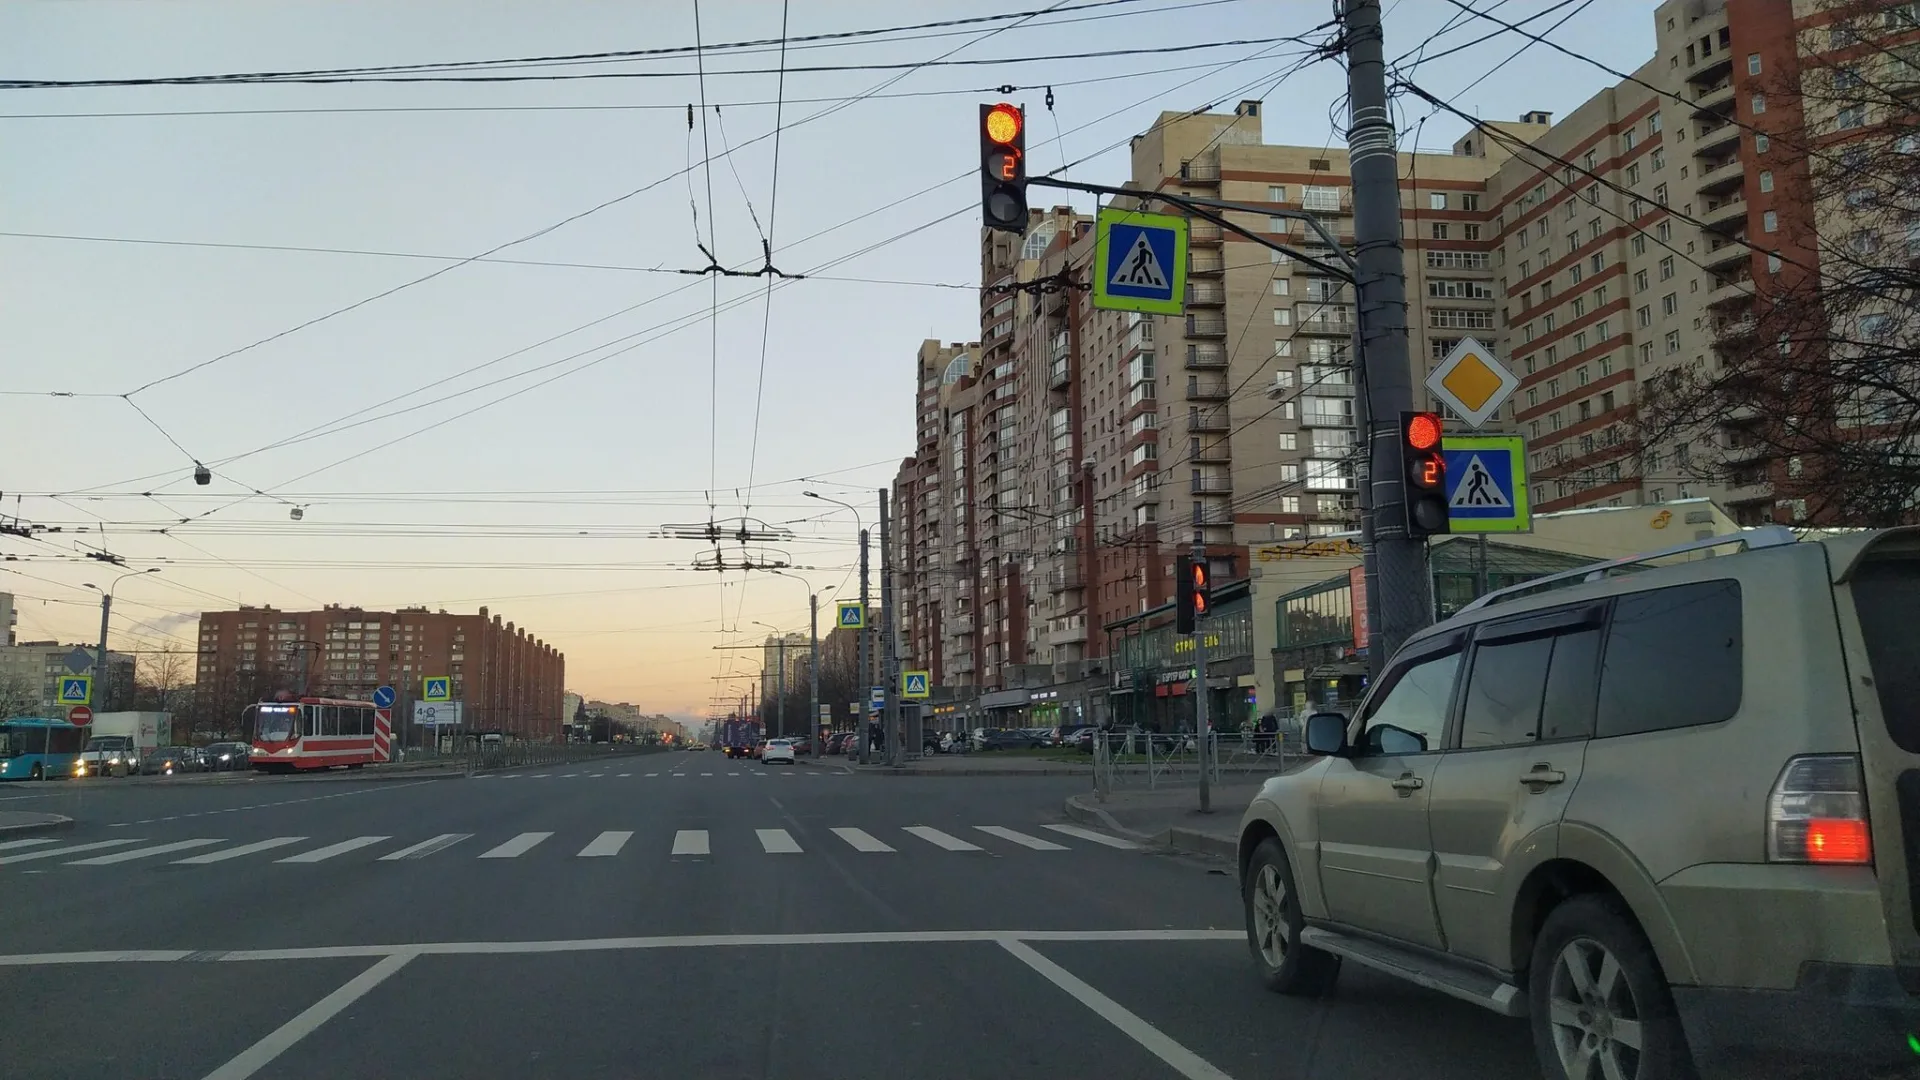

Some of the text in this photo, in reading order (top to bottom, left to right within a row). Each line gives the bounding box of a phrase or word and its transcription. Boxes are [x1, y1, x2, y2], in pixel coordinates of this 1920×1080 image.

[1003, 156, 1014, 177] 2
[1425, 462, 1436, 482] 2
[1175, 635, 1219, 653] СТРОЕЛЬ
